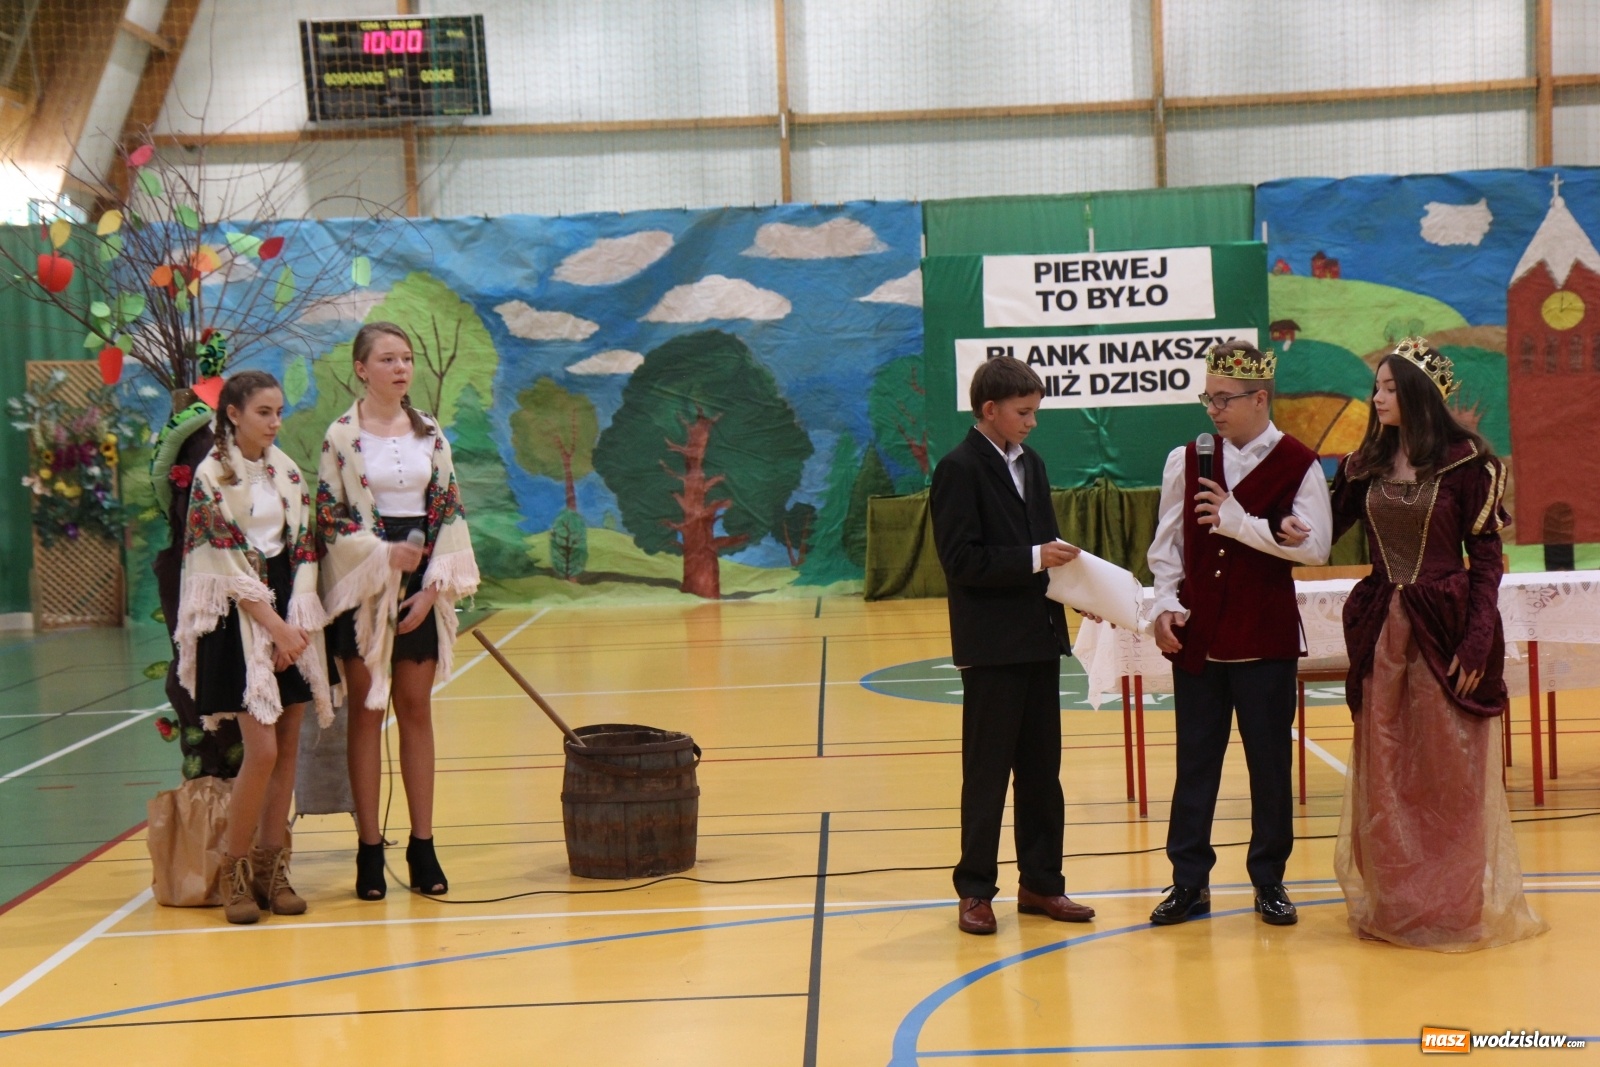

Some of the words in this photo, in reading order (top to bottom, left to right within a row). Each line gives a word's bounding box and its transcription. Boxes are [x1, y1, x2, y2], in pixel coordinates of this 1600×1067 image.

[363, 30, 422, 54] 10:00
[1034, 257, 1168, 283] PIERWEJ
[1036, 290, 1078, 312] TO
[1087, 284, 1169, 310] BYŁO
[1090, 368, 1190, 395] DZISIO
